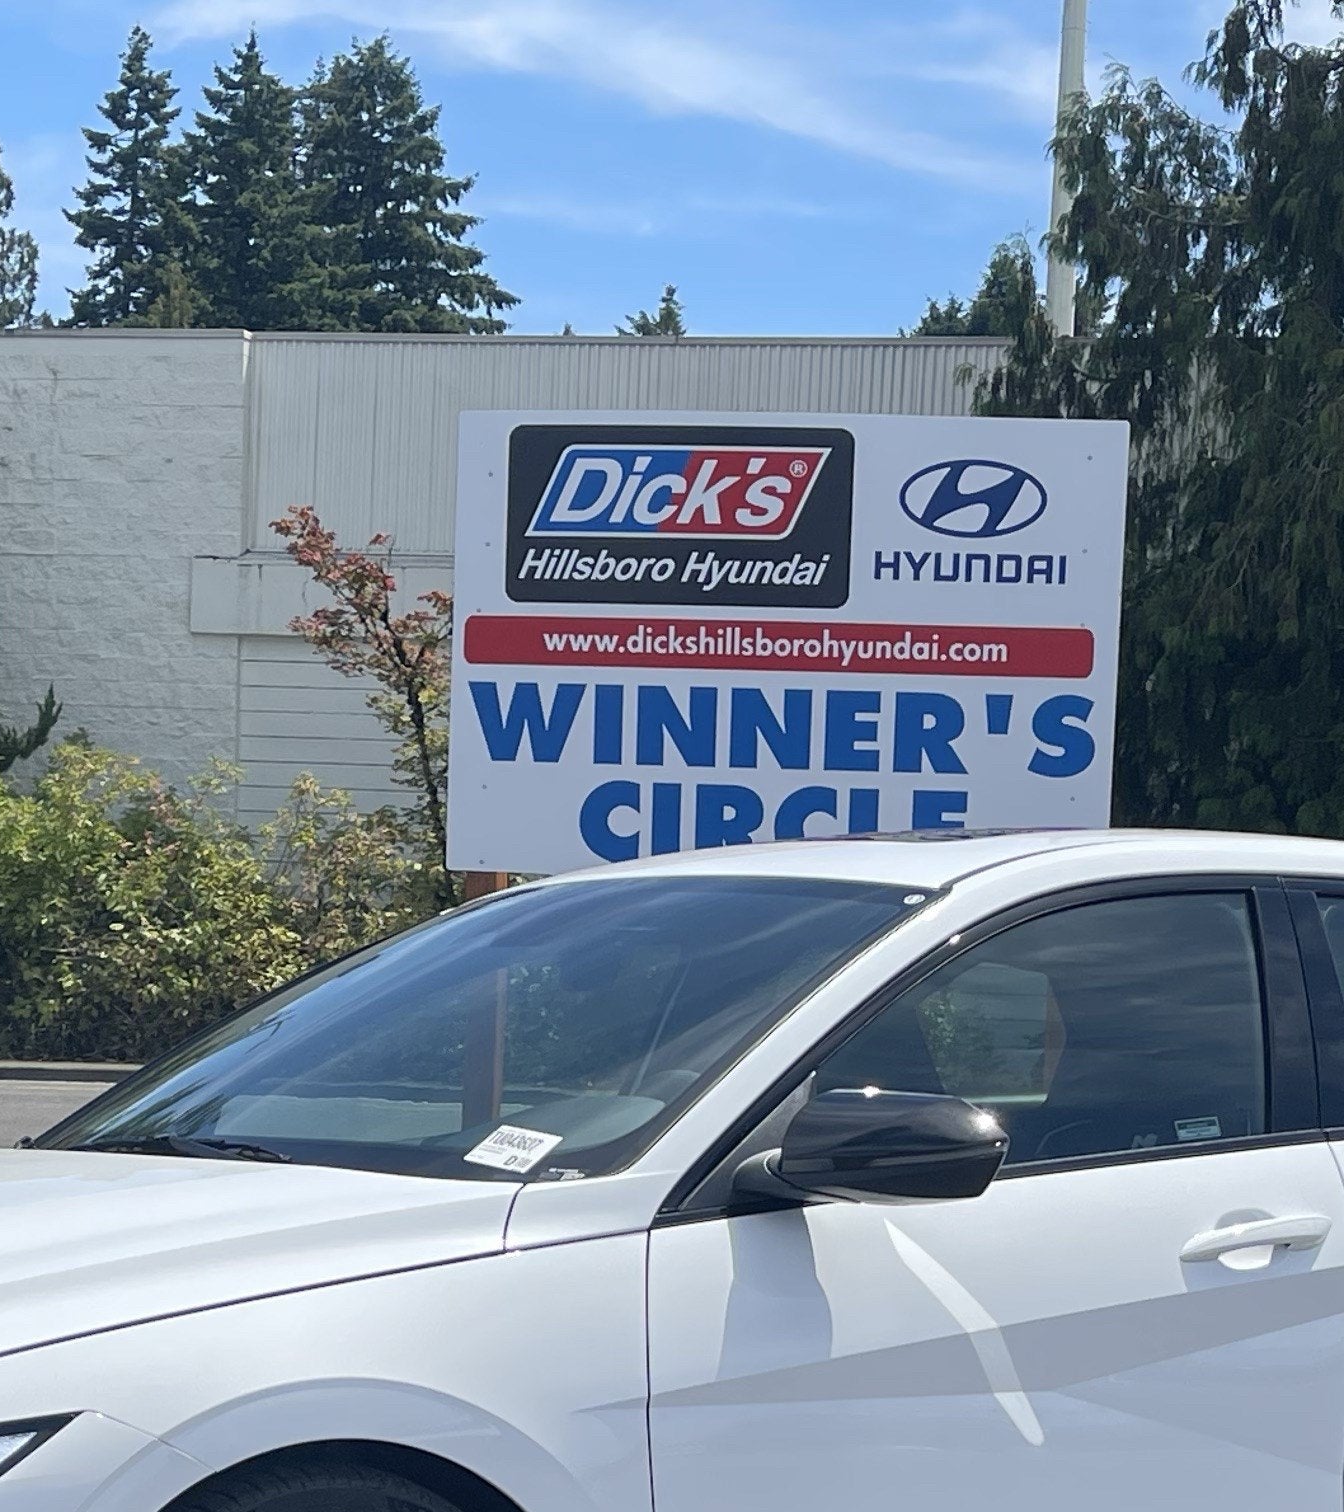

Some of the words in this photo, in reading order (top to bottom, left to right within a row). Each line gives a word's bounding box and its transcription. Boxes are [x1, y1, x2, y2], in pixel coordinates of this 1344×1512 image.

[550, 455, 795, 524] Dick's
[517, 548, 676, 582] Hillsboro
[680, 552, 830, 592] Hyundai
[873, 550, 1068, 585] HYUNDAI
[543, 624, 1009, 666] www.dickshillsborohyundai.com
[467, 680, 1096, 779] WINNER'S
